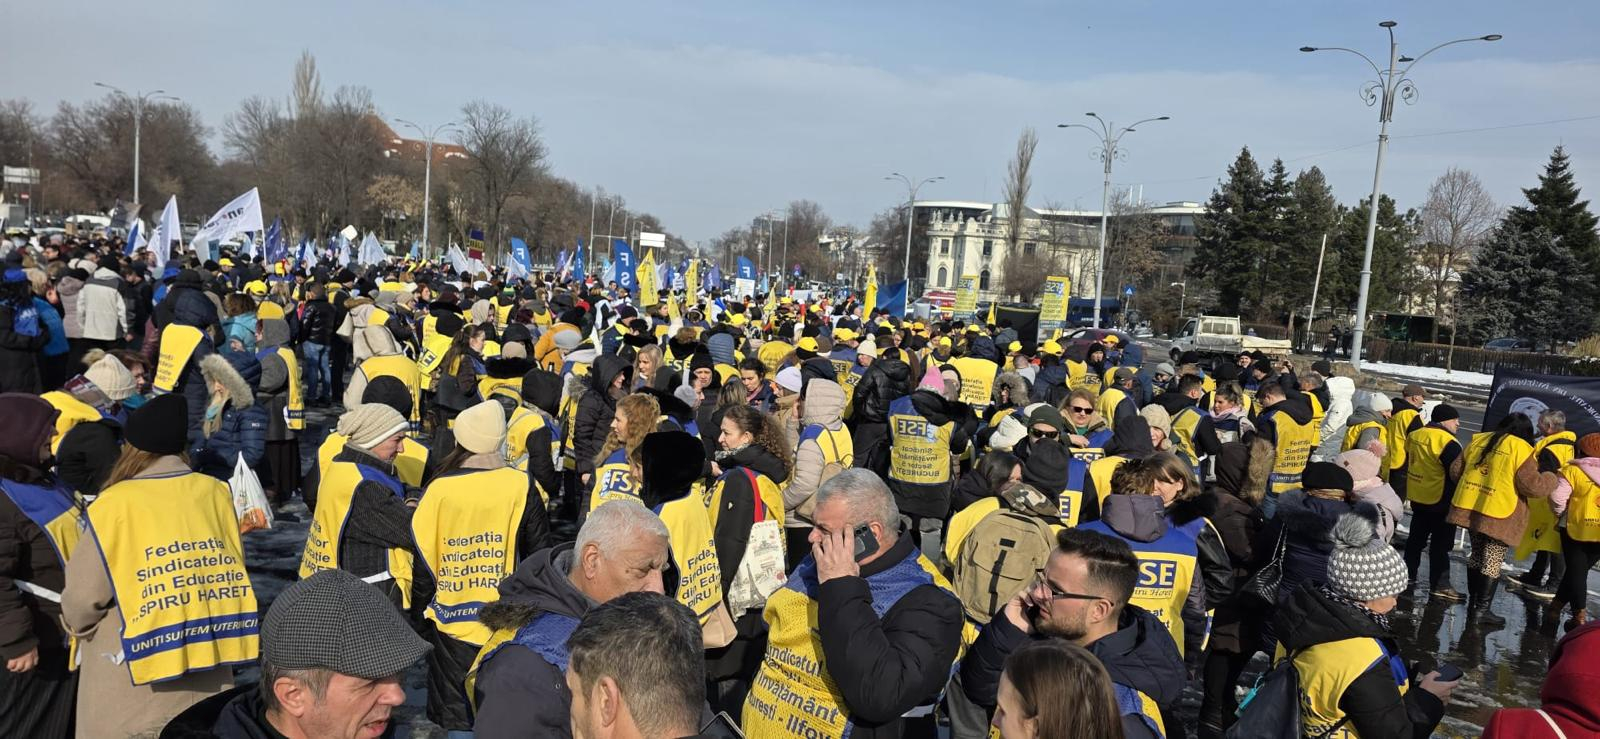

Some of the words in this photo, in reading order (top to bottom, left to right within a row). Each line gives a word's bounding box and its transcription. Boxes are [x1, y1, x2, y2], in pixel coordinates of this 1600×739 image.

[444, 531, 502, 546] ederația
[145, 537, 224, 561] Federația
[441, 547, 504, 562] indicatelo
[452, 562, 504, 578] Educați
[1139, 562, 1175, 586] SE
[142, 583, 166, 599] din
[172, 570, 244, 589] Educație
